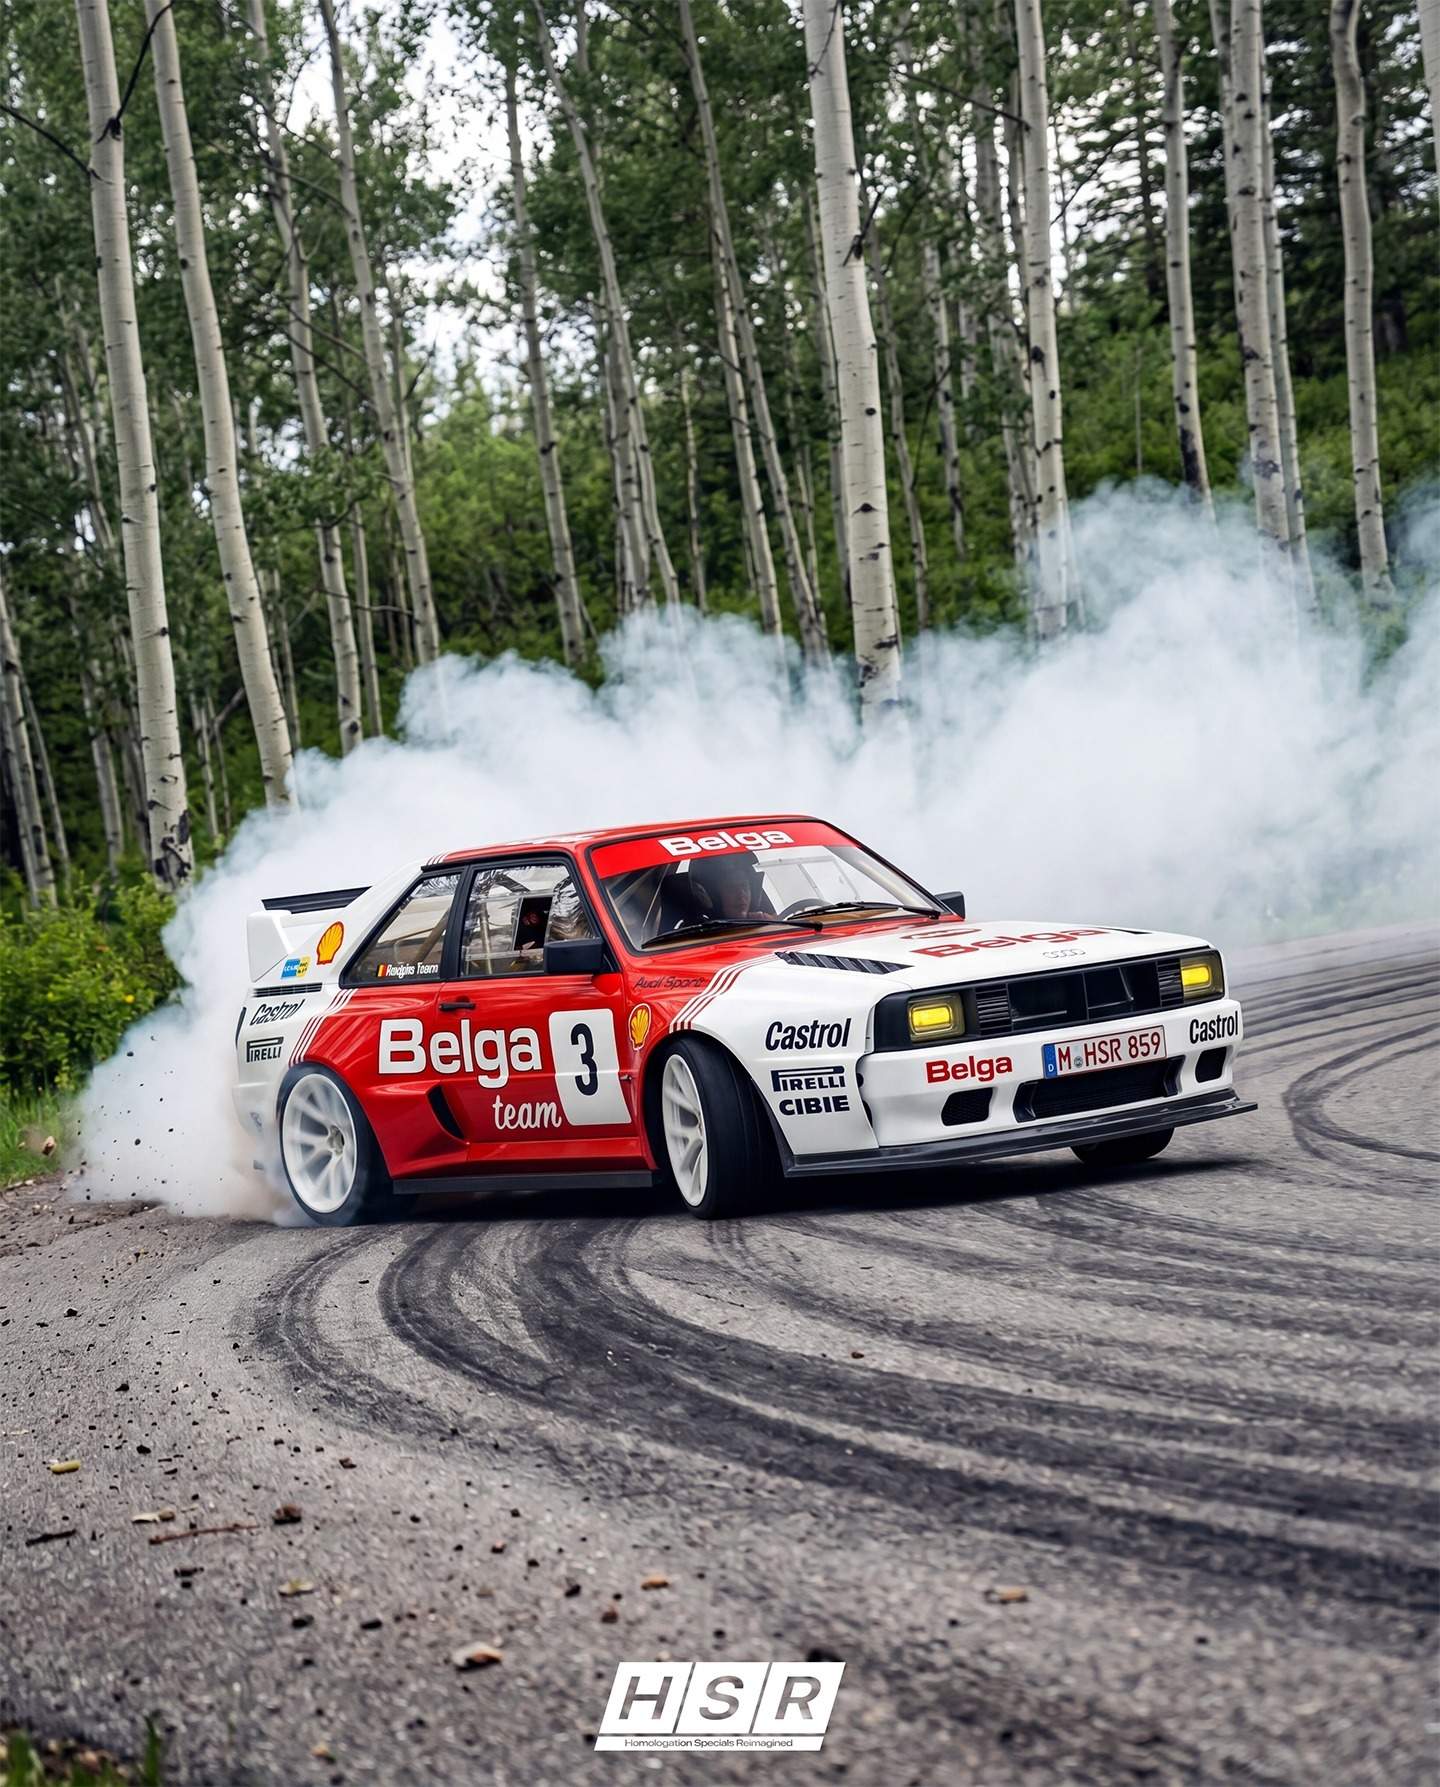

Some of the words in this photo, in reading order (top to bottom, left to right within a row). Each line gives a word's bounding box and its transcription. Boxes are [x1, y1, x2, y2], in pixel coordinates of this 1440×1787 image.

[658, 830, 795, 857] Belga
[909, 929, 1110, 958] Belga
[249, 998, 306, 1026] Castrol
[765, 1018, 852, 1051] Castrol
[1190, 1010, 1239, 1044] Castrol
[246, 1036, 284, 1063] PIRELLI
[378, 1018, 543, 1089] Belga
[570, 1023, 599, 1096] 3
[1058, 1046, 1072, 1071] M
[1084, 1038, 1122, 1067] HSR
[1128, 1031, 1161, 1059] 859
[770, 1065, 846, 1092] PIRELLI
[925, 1055, 1013, 1084] Belga
[1048, 1063, 1055, 1072] D
[492, 1094, 562, 1130] team
[779, 1095, 850, 1116] CIBIE
